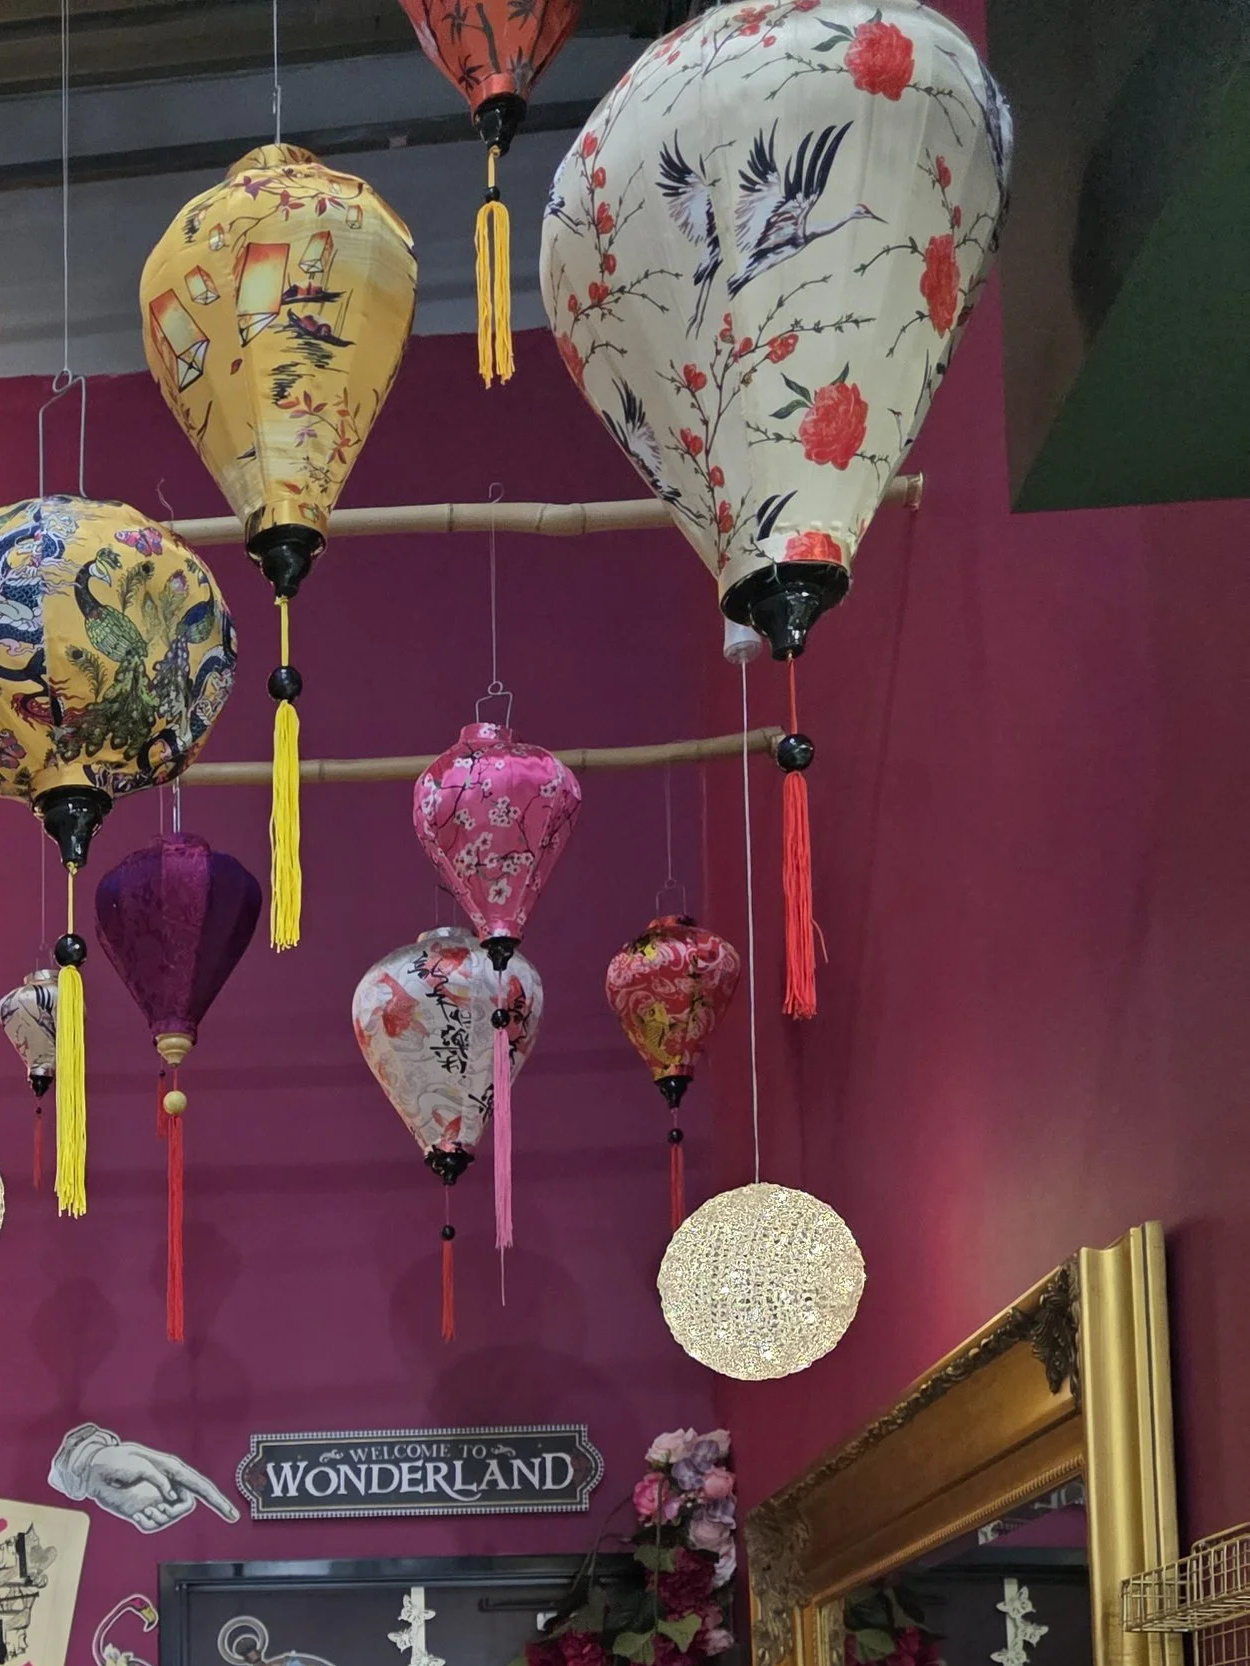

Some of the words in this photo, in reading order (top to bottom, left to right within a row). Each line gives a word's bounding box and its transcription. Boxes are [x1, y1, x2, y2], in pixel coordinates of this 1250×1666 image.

[349, 1443, 451, 1463] WELCOME
[460, 1444, 486, 1459] TO
[266, 1452, 574, 1501] WONDERLAND
